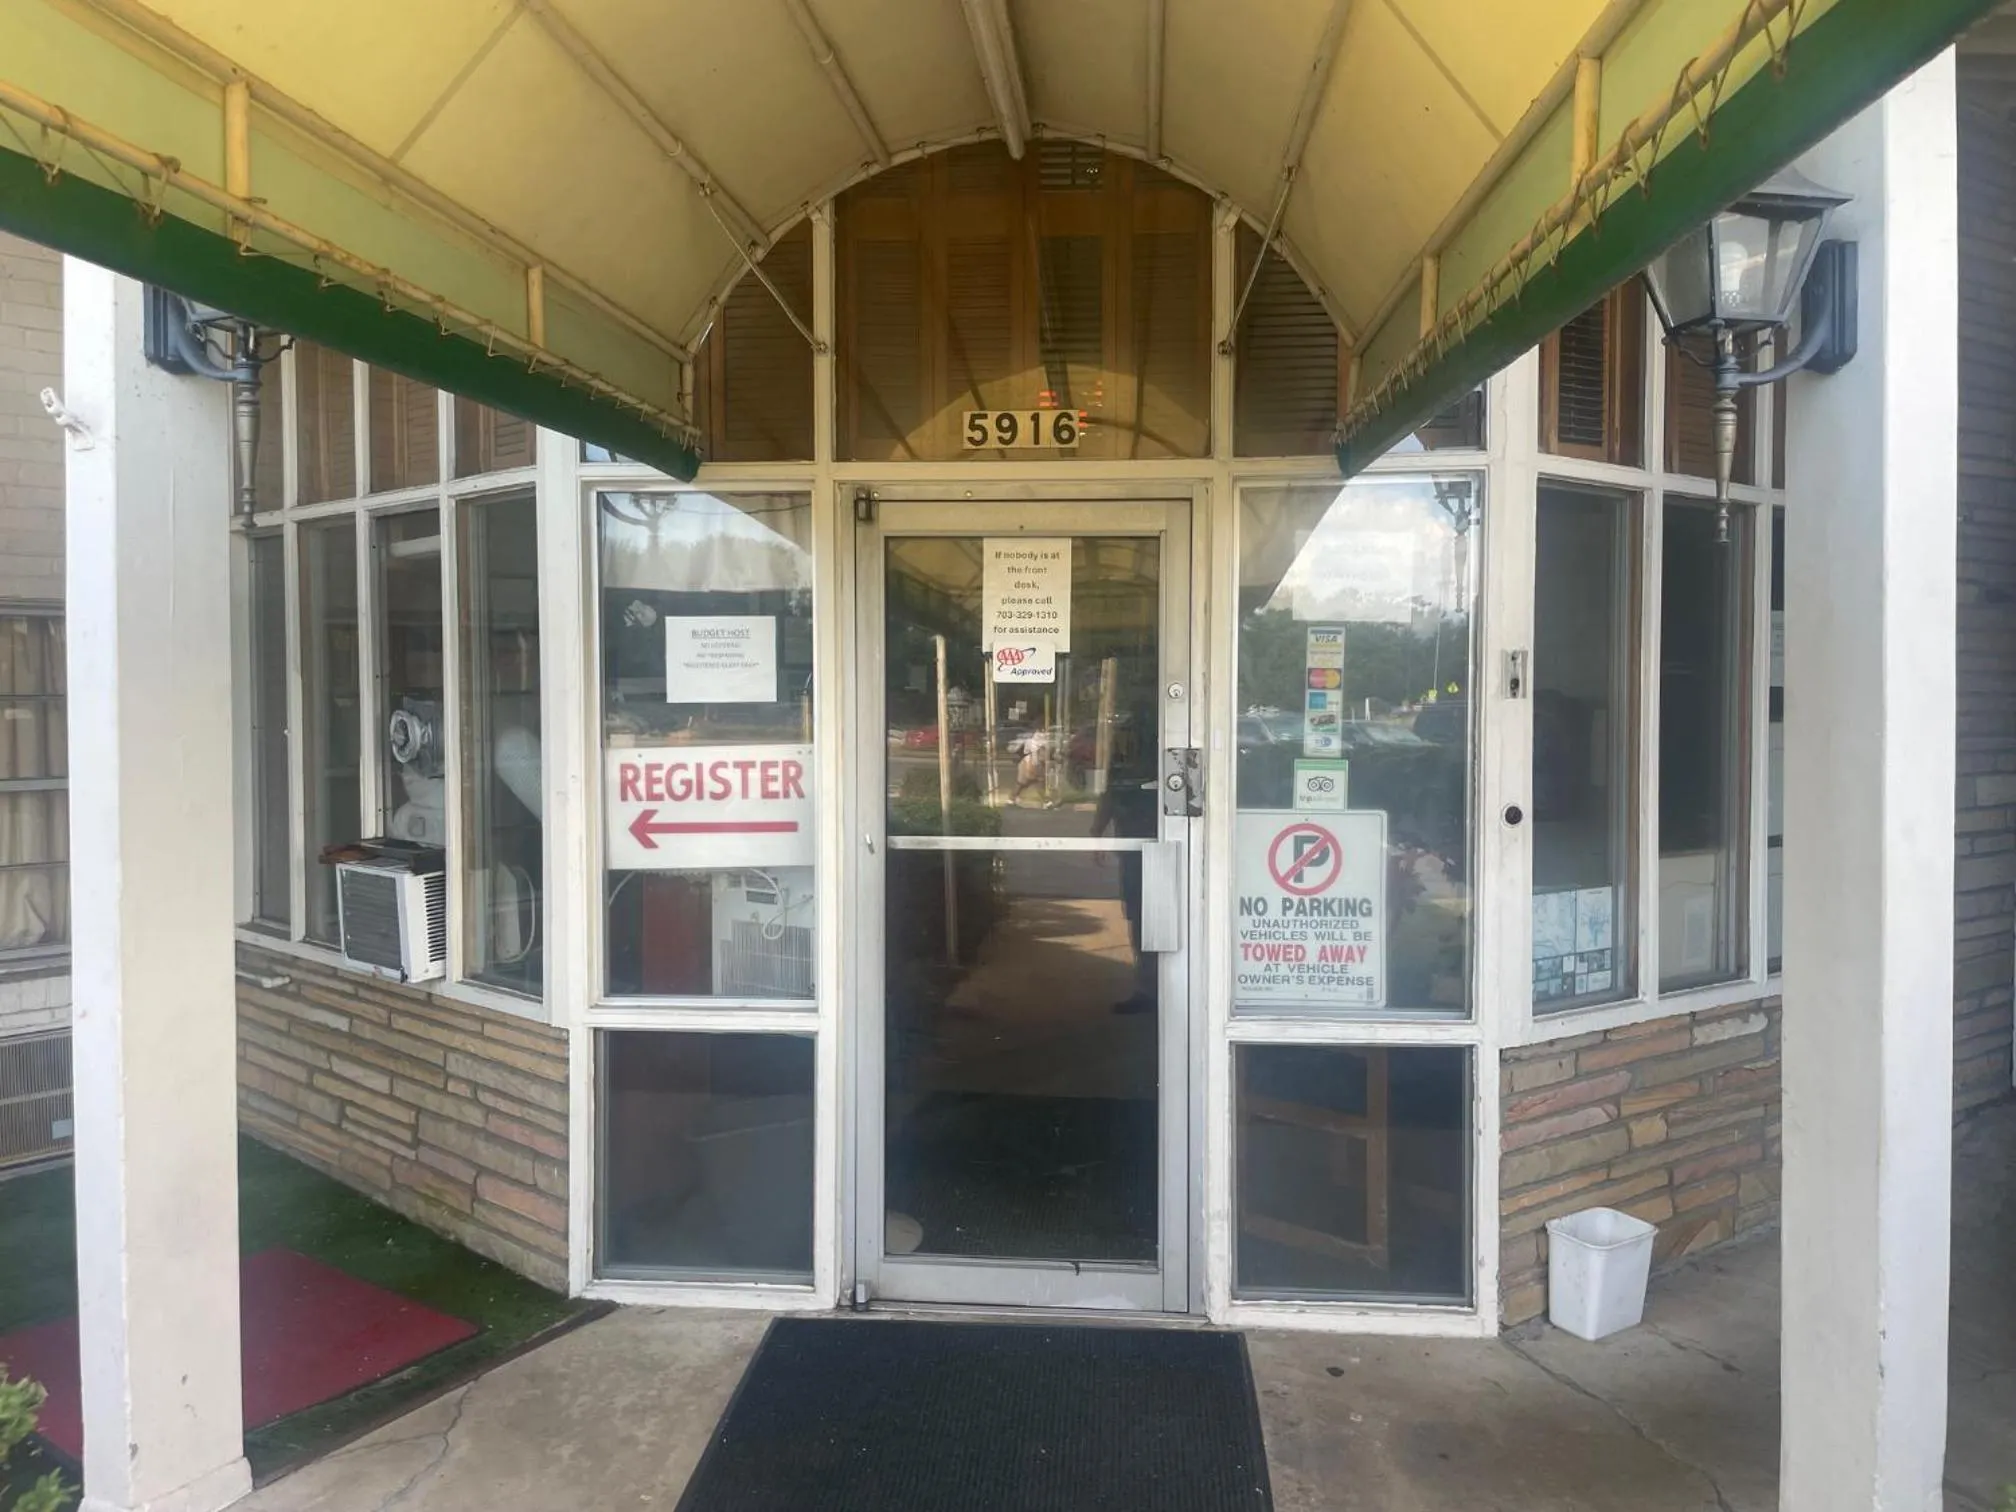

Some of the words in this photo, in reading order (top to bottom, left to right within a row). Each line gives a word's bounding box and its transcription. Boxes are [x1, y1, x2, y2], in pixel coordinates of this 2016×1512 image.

[967, 411, 1076, 447] 5916
[995, 551, 1002, 560] If
[1003, 551, 1039, 561] nobody
[1040, 551, 1049, 560] is
[1050, 551, 1061, 560] at
[1007, 566, 1022, 574] the
[1024, 566, 1048, 574] front
[1014, 581, 1040, 590] desk,
[1001, 597, 1033, 606] please
[1035, 596, 1053, 604] call
[997, 611, 1058, 620] 703-329-1310
[994, 626, 1007, 634] for
[1008, 626, 1060, 634] assistance
[1315, 634, 1338, 643] VISA
[1010, 666, 1054, 677] Approved
[620, 760, 806, 803] REGISTER
[1239, 897, 1268, 917] NO
[1281, 897, 1373, 917] PARKING
[1253, 918, 1359, 930] UNAUTHORIZED
[1240, 930, 1308, 941] VEHICLES
[1315, 931, 1347, 942] WILL
[1353, 931, 1373, 942] BE
[1240, 943, 1307, 963] TOWED
[1317, 944, 1367, 964] AWAY
[1264, 963, 1281, 973] AT
[1288, 964, 1349, 974] VEHICLE
[1238, 974, 1304, 985] OWNER'S
[1308, 976, 1374, 987] EXPENSE
